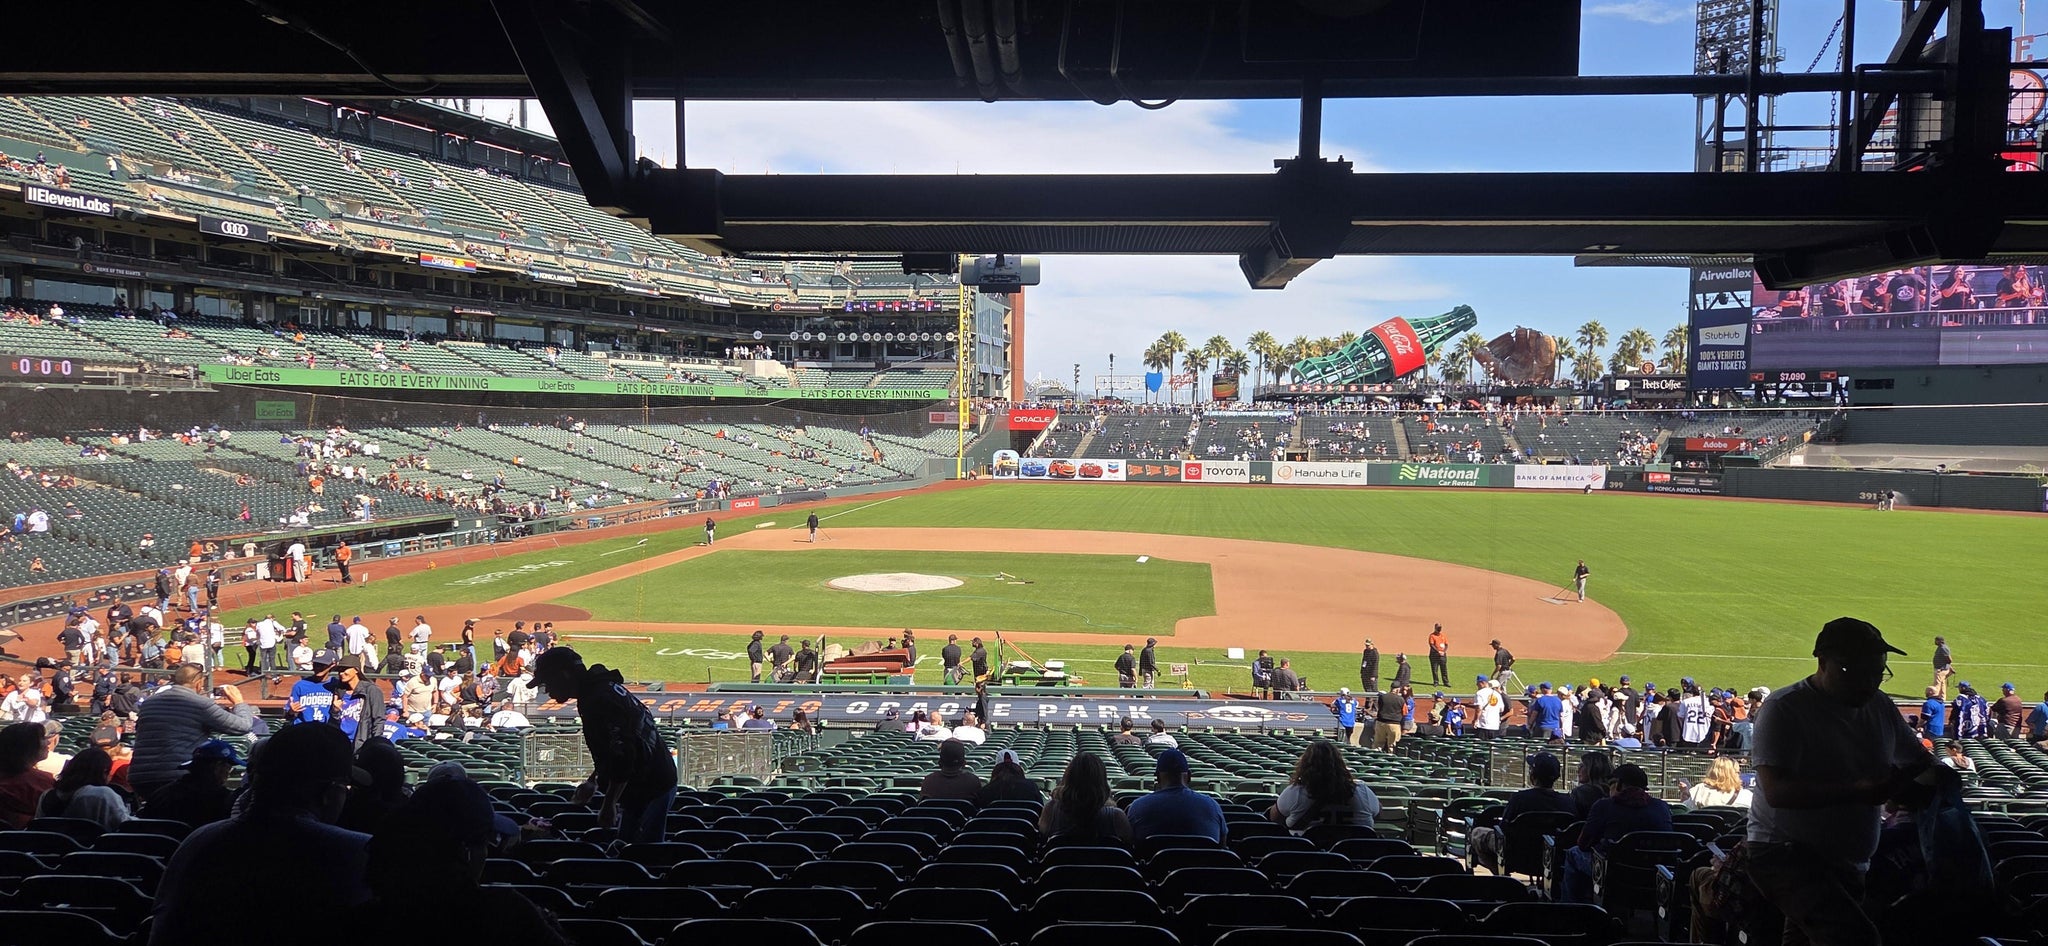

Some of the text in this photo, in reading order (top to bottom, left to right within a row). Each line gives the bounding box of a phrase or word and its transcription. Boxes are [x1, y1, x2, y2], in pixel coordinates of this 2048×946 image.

[1699, 268, 1752, 281] Airwallex
[1704, 331, 1740, 340] StubHub
[1700, 349, 1745, 360] 100% VERIFIED
[20, 359, 30, 374] 0
[41, 360, 51, 374] 0
[61, 360, 71, 375] 0
[1697, 360, 1746, 371] GIANTS TICKETS
[225, 368, 280, 381] Uber Eats
[1780, 372, 1806, 381] $7,090
[340, 373, 489, 389] EATS FOR EVERY INNING
[538, 380, 576, 391] Uber Eats
[1660, 379, 1681, 390] Coffee
[616, 383, 714, 396] EATS FOR EVERY INNING
[745, 387, 757, 396] Uber
[800, 389, 931, 398] EATS FOR EVERY INNING
[258, 408, 293, 417] Uber Eats
[1205, 467, 1246, 476] TOYOTA
[1295, 469, 1362, 478] Hanwha Life
[1418, 466, 1478, 480] National
[1858, 491, 1877, 500] 391
[300, 695, 333, 707] DODGER
[773, 700, 823, 714] TO
[846, 701, 1012, 716] ORACE
[1038, 704, 1152, 719] PARK
[1345, 703, 1352, 713] 8
